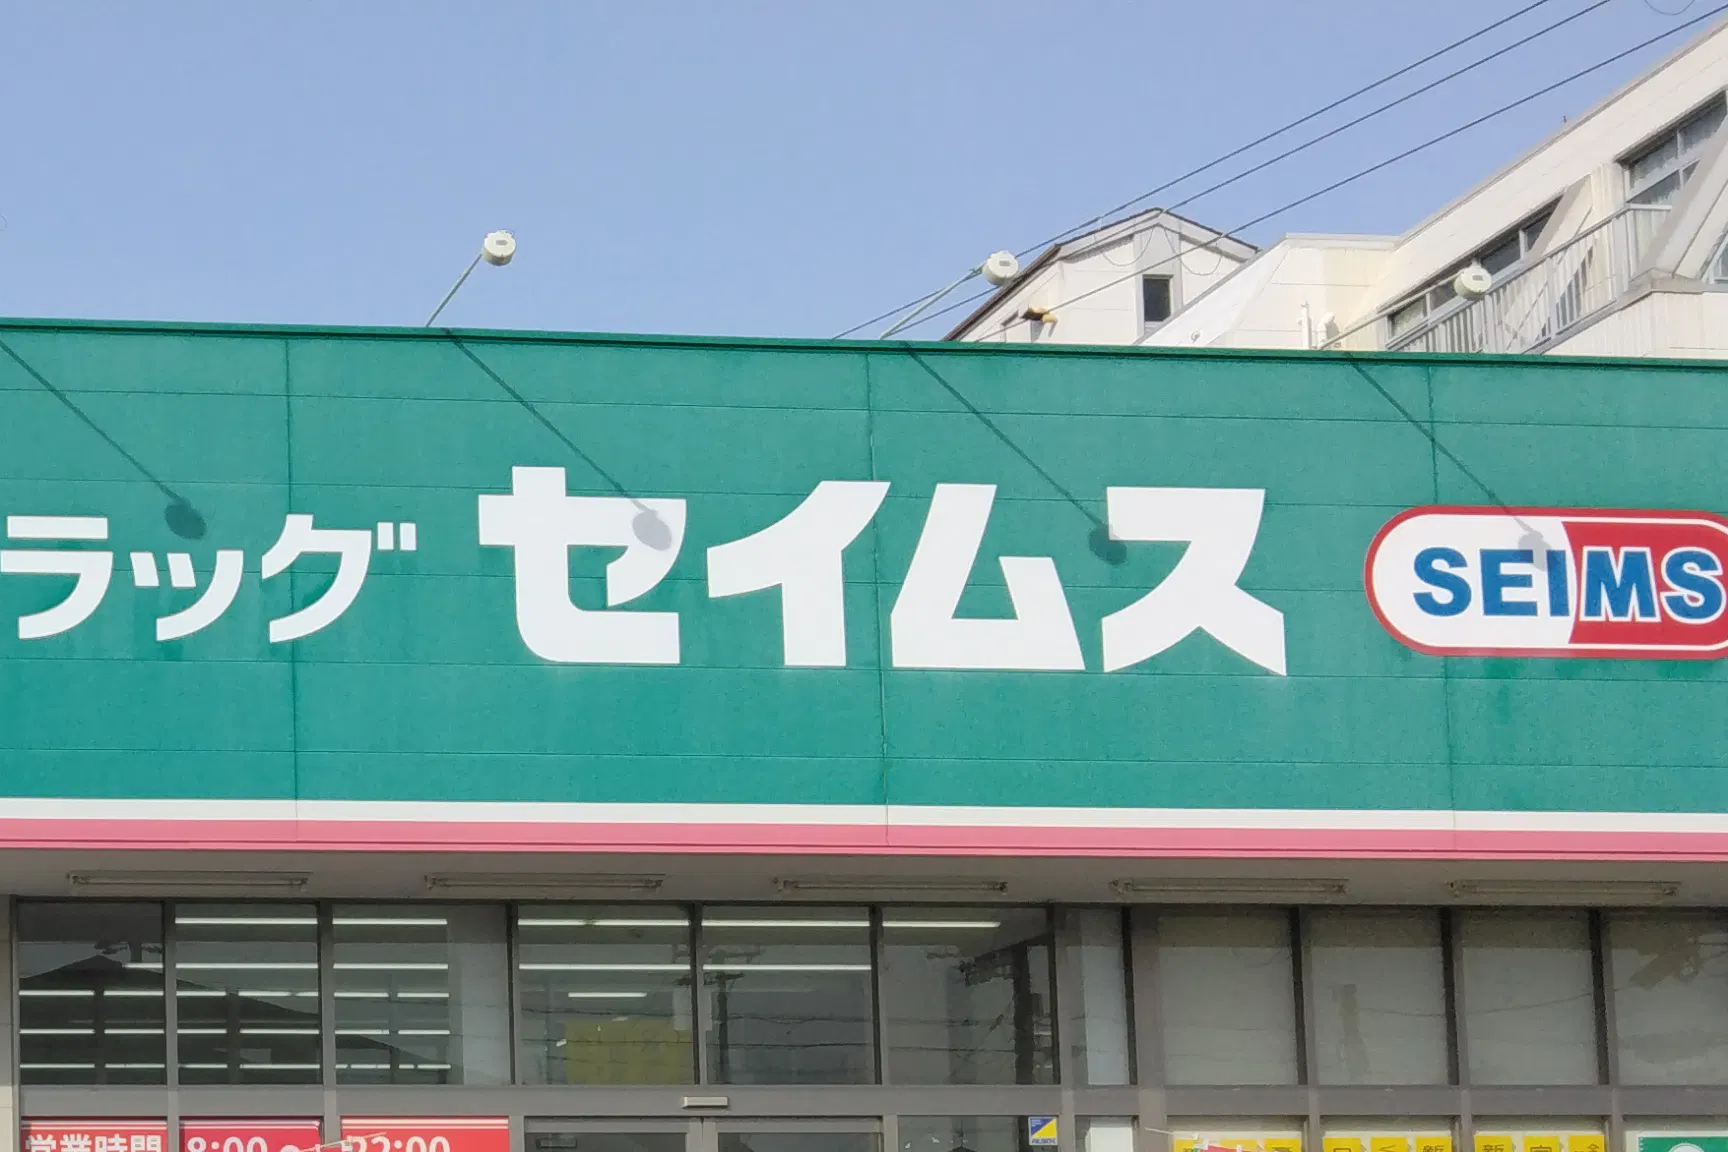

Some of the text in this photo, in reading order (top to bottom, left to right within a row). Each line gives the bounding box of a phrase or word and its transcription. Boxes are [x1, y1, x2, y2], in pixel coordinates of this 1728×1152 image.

[478, 466, 1287, 676] セイムス
[1413, 546, 1726, 624] SEIMS
